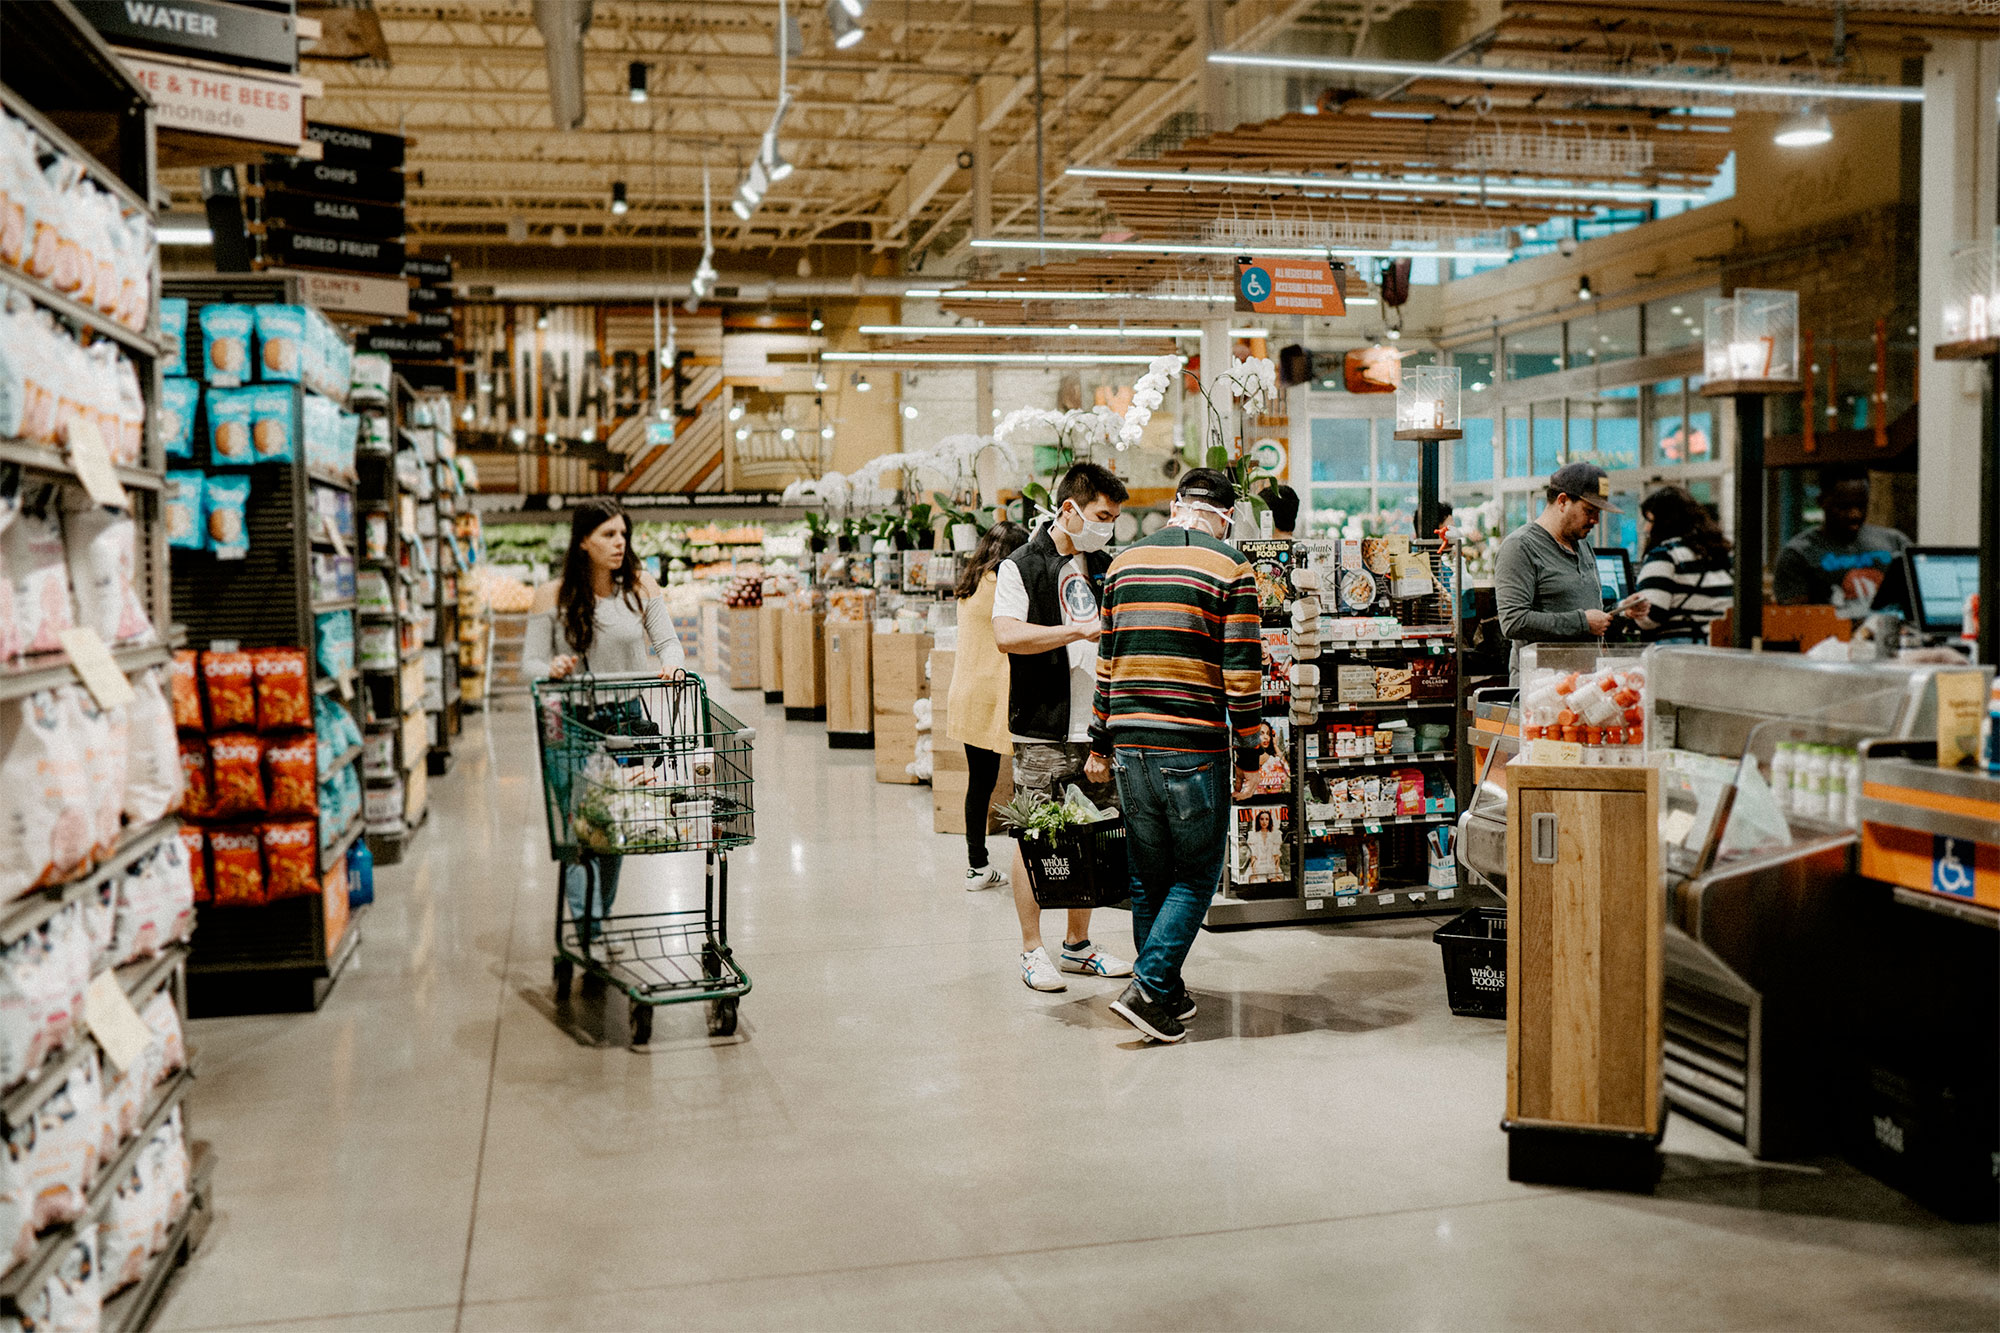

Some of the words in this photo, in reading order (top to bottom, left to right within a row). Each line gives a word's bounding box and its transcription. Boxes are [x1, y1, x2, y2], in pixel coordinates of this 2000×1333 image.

[125, 2, 217, 37] WATER
[167, 73, 181, 93] &
[189, 79, 231, 101] THE
[239, 86, 290, 111] BEES
[153, 104, 245, 128] monade
[308, 127, 372, 149] OPCORN
[314, 165, 357, 185] CHIPS
[314, 201, 359, 220] SALSA
[293, 234, 337, 252] DRIED
[339, 240, 379, 258] FRUIT
[1760, 336, 1775, 378] 7
[1242, 543, 1289, 552] PLANT-BASED
[205, 660, 253, 678] dang
[255, 659, 302, 677] dang
[1389, 671, 1404, 682] dang
[1388, 686, 1404, 697] dang
[212, 744, 258, 763] dang
[266, 746, 312, 765] dang
[211, 833, 259, 852] dang
[264, 828, 310, 846] dang
[1041, 858, 1069, 867] WHOLE
[1044, 866, 1070, 876] FOODS
[1470, 967, 1505, 979] WHOLE
[1472, 977, 1505, 987] FOODS
